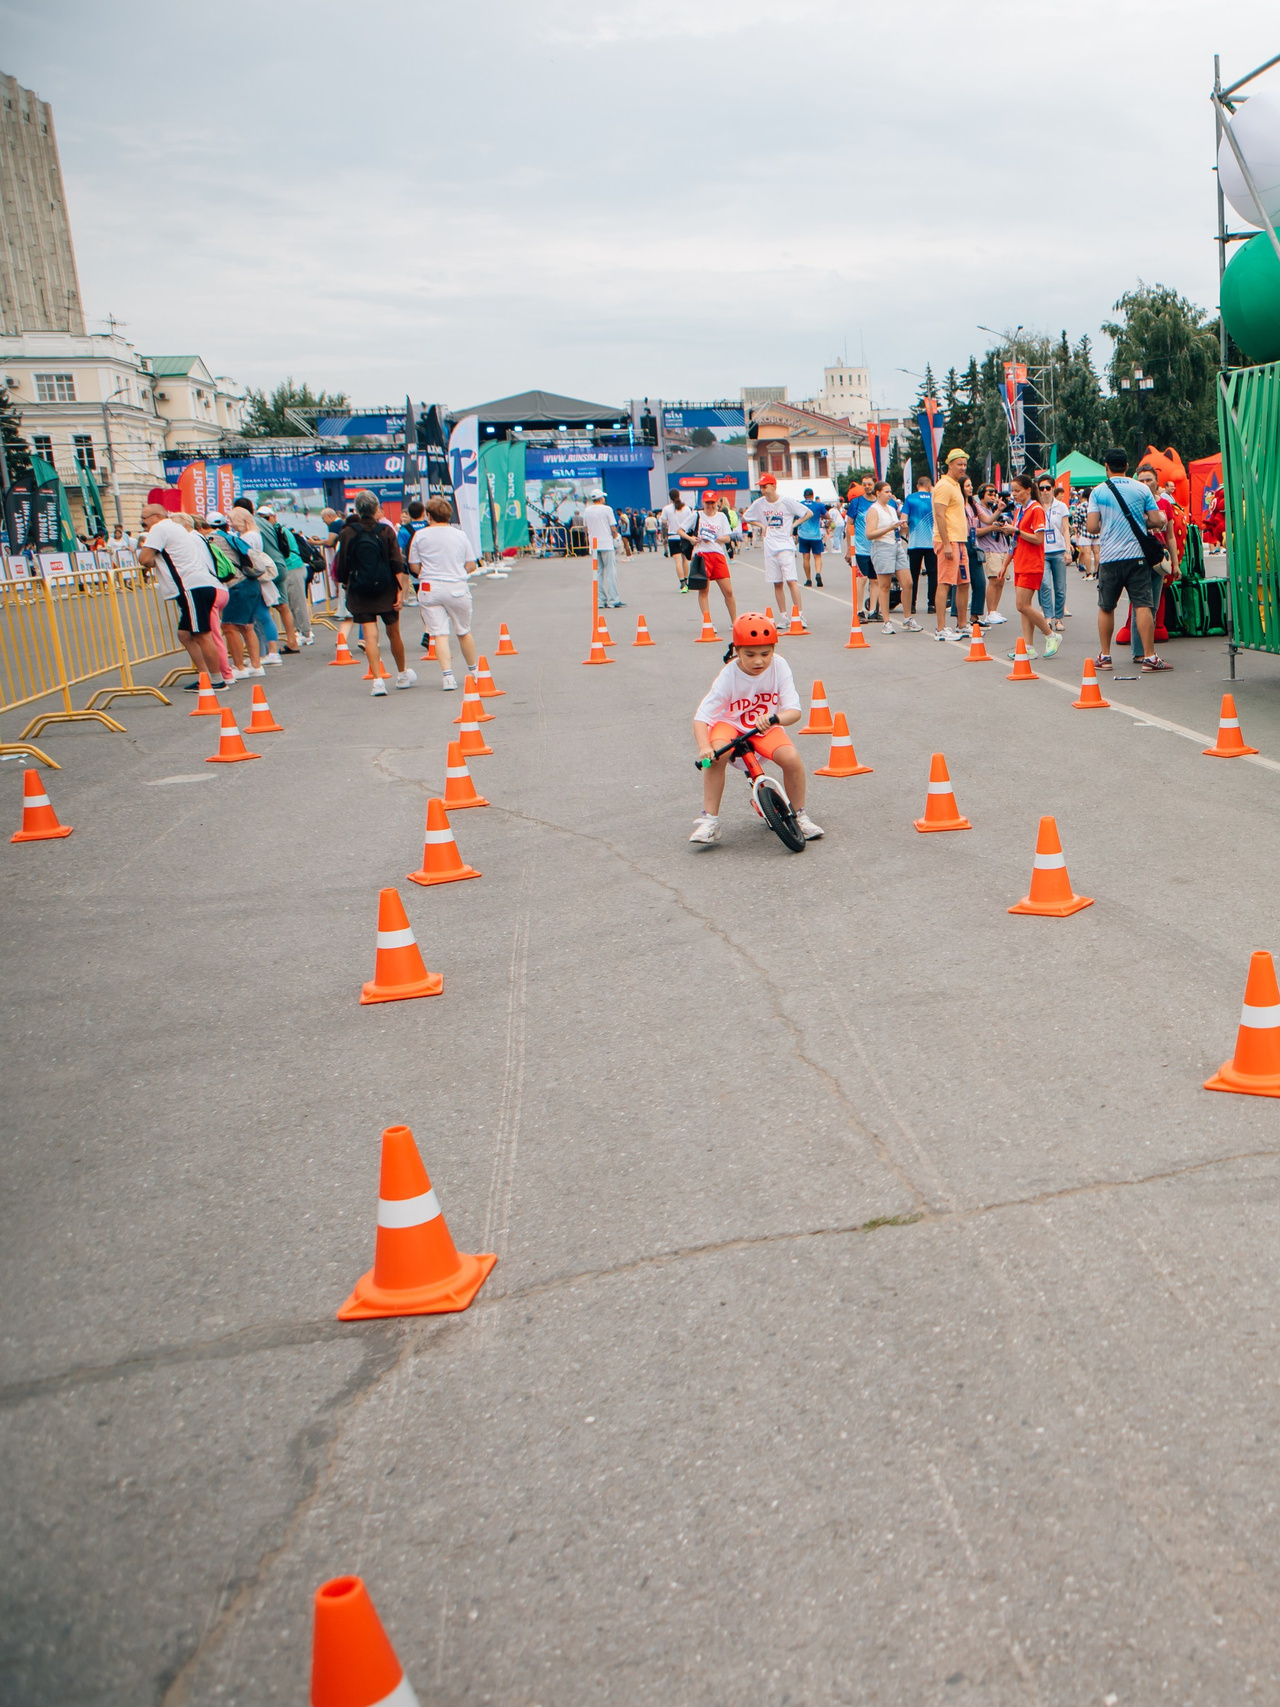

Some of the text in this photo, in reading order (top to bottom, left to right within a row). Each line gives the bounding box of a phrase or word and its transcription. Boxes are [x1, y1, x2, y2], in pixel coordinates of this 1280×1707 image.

[752, 415, 801, 428] КОВСКИЙ
[315, 460, 350, 472] 9:46:45
[193, 468, 205, 516] ДОПЫТ
[206, 470, 217, 513] ДОПЫТ
[221, 472, 232, 514] ДОПЫТ
